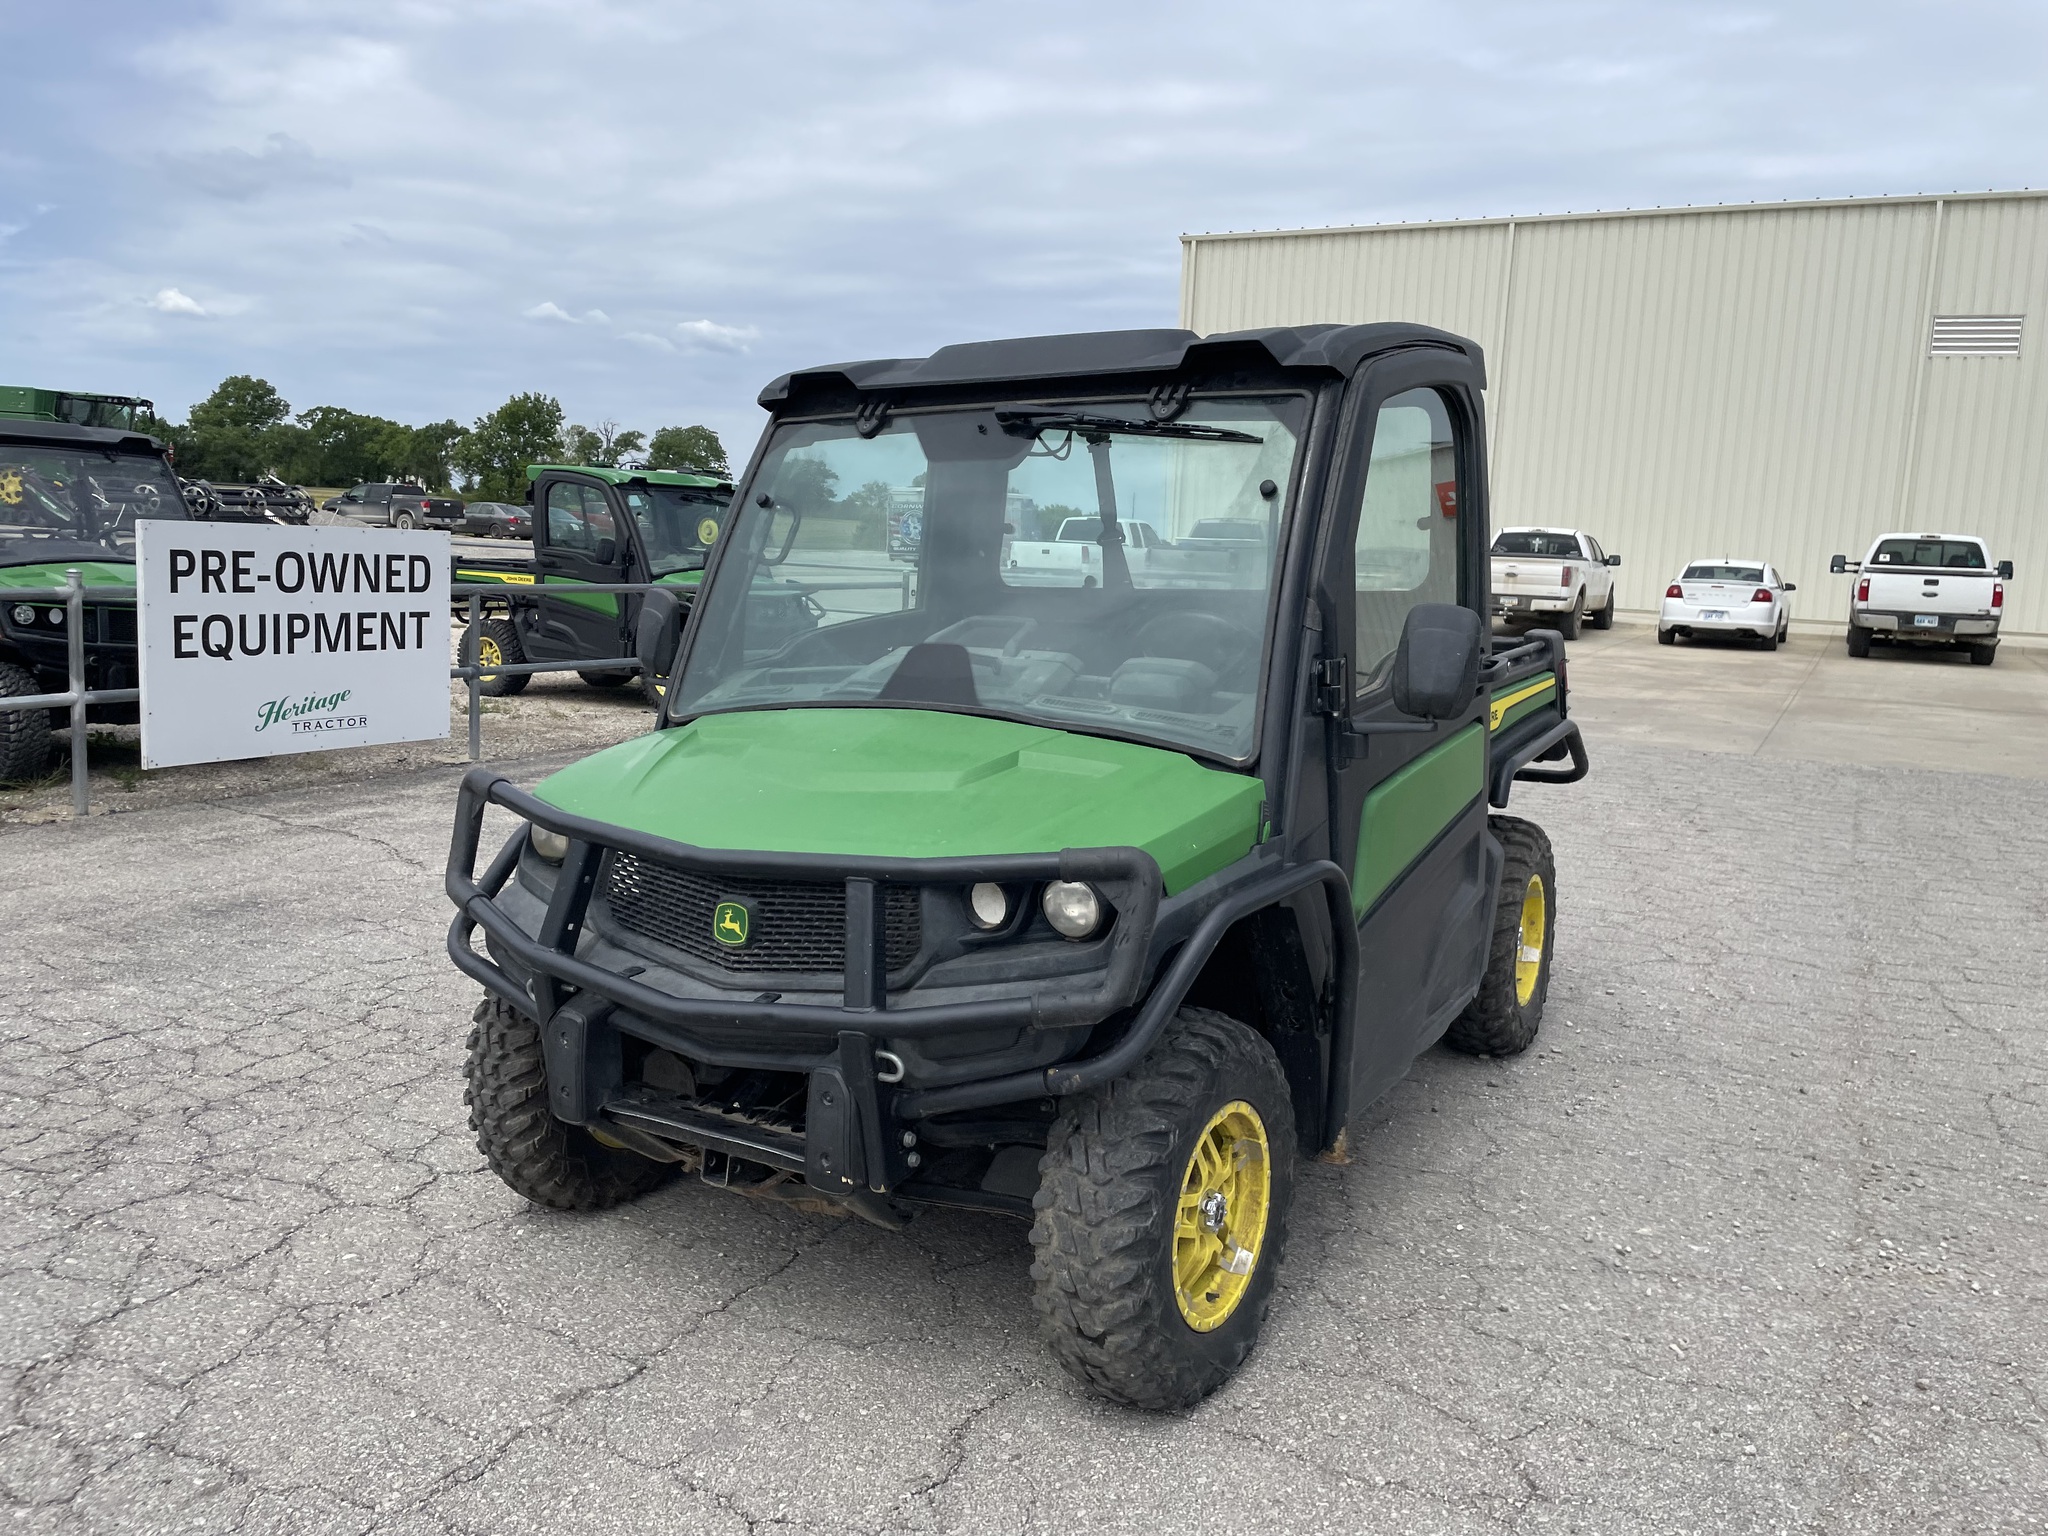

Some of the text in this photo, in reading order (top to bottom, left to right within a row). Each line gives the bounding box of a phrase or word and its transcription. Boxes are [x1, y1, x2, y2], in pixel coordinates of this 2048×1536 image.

[170, 550, 431, 594] PRE-OWNED
[174, 612, 430, 660] EQUIPMENT
[255, 689, 351, 732] Heritage
[292, 717, 367, 732] TRACTOR
